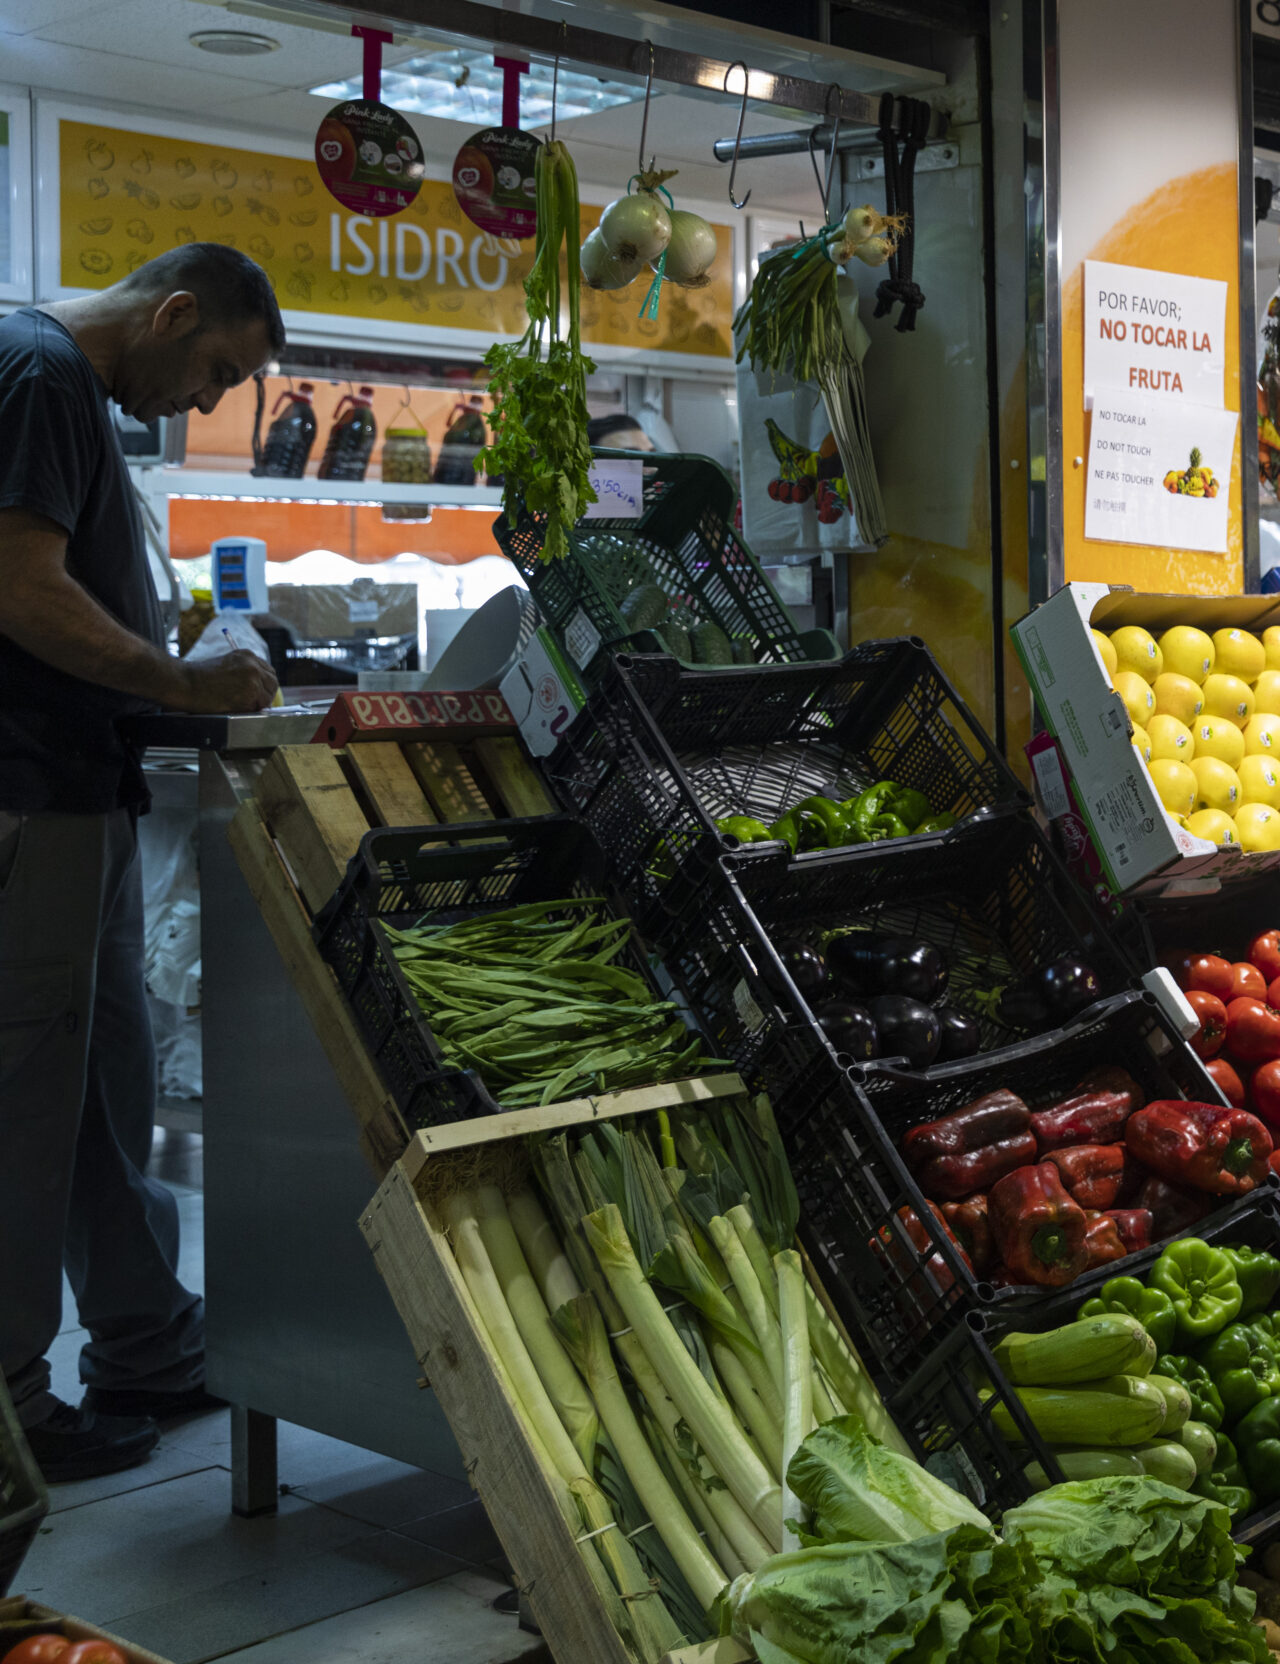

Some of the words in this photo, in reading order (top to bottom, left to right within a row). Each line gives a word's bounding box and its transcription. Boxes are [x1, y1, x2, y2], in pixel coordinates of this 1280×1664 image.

[343, 103, 370, 118] Pink
[370, 110, 395, 126] Lady
[481, 132, 509, 145] Pink
[508, 136, 534, 151] Lady
[329, 212, 509, 292] ISIDRO
[1098, 290, 1128, 311] POR
[1099, 317, 1127, 341] NO
[1131, 322, 1188, 350] TOCAR
[1192, 331, 1212, 353] LA
[1129, 366, 1184, 393] FRUTA
[1099, 410, 1111, 421] NO
[1113, 412, 1137, 424] TOCAR
[1138, 416, 1147, 427] LA
[1096, 439, 1109, 450] DO
[1110, 442, 1125, 453] NOT
[1126, 444, 1152, 457] TOUCH
[1094, 469, 1104, 480] NE
[1106, 471, 1120, 482] PAS
[1122, 473, 1155, 486] TOUCHER
